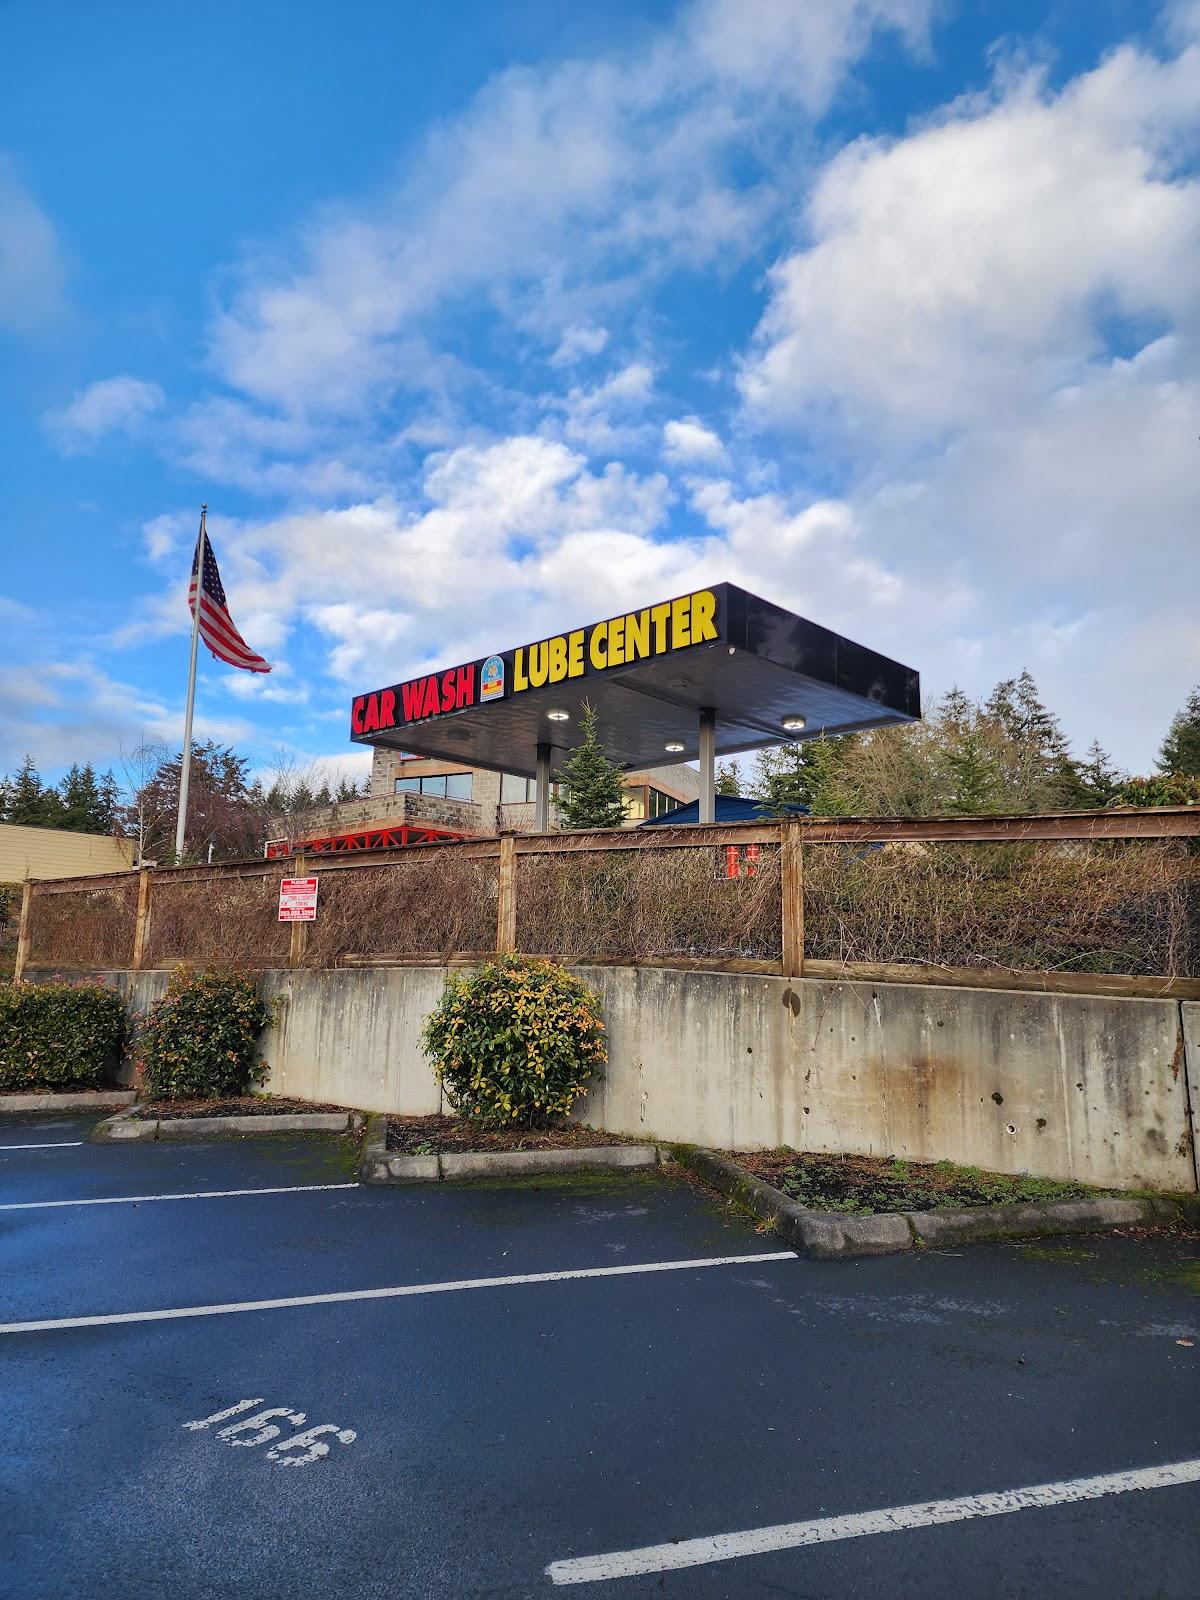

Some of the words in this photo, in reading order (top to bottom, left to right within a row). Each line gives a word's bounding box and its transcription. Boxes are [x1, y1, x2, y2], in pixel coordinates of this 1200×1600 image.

[513, 630, 585, 693] LUBE
[589, 591, 718, 670] CENTER
[352, 690, 395, 734] CAR
[401, 665, 475, 721] WASH
[181, 1398, 357, 1467] 166
